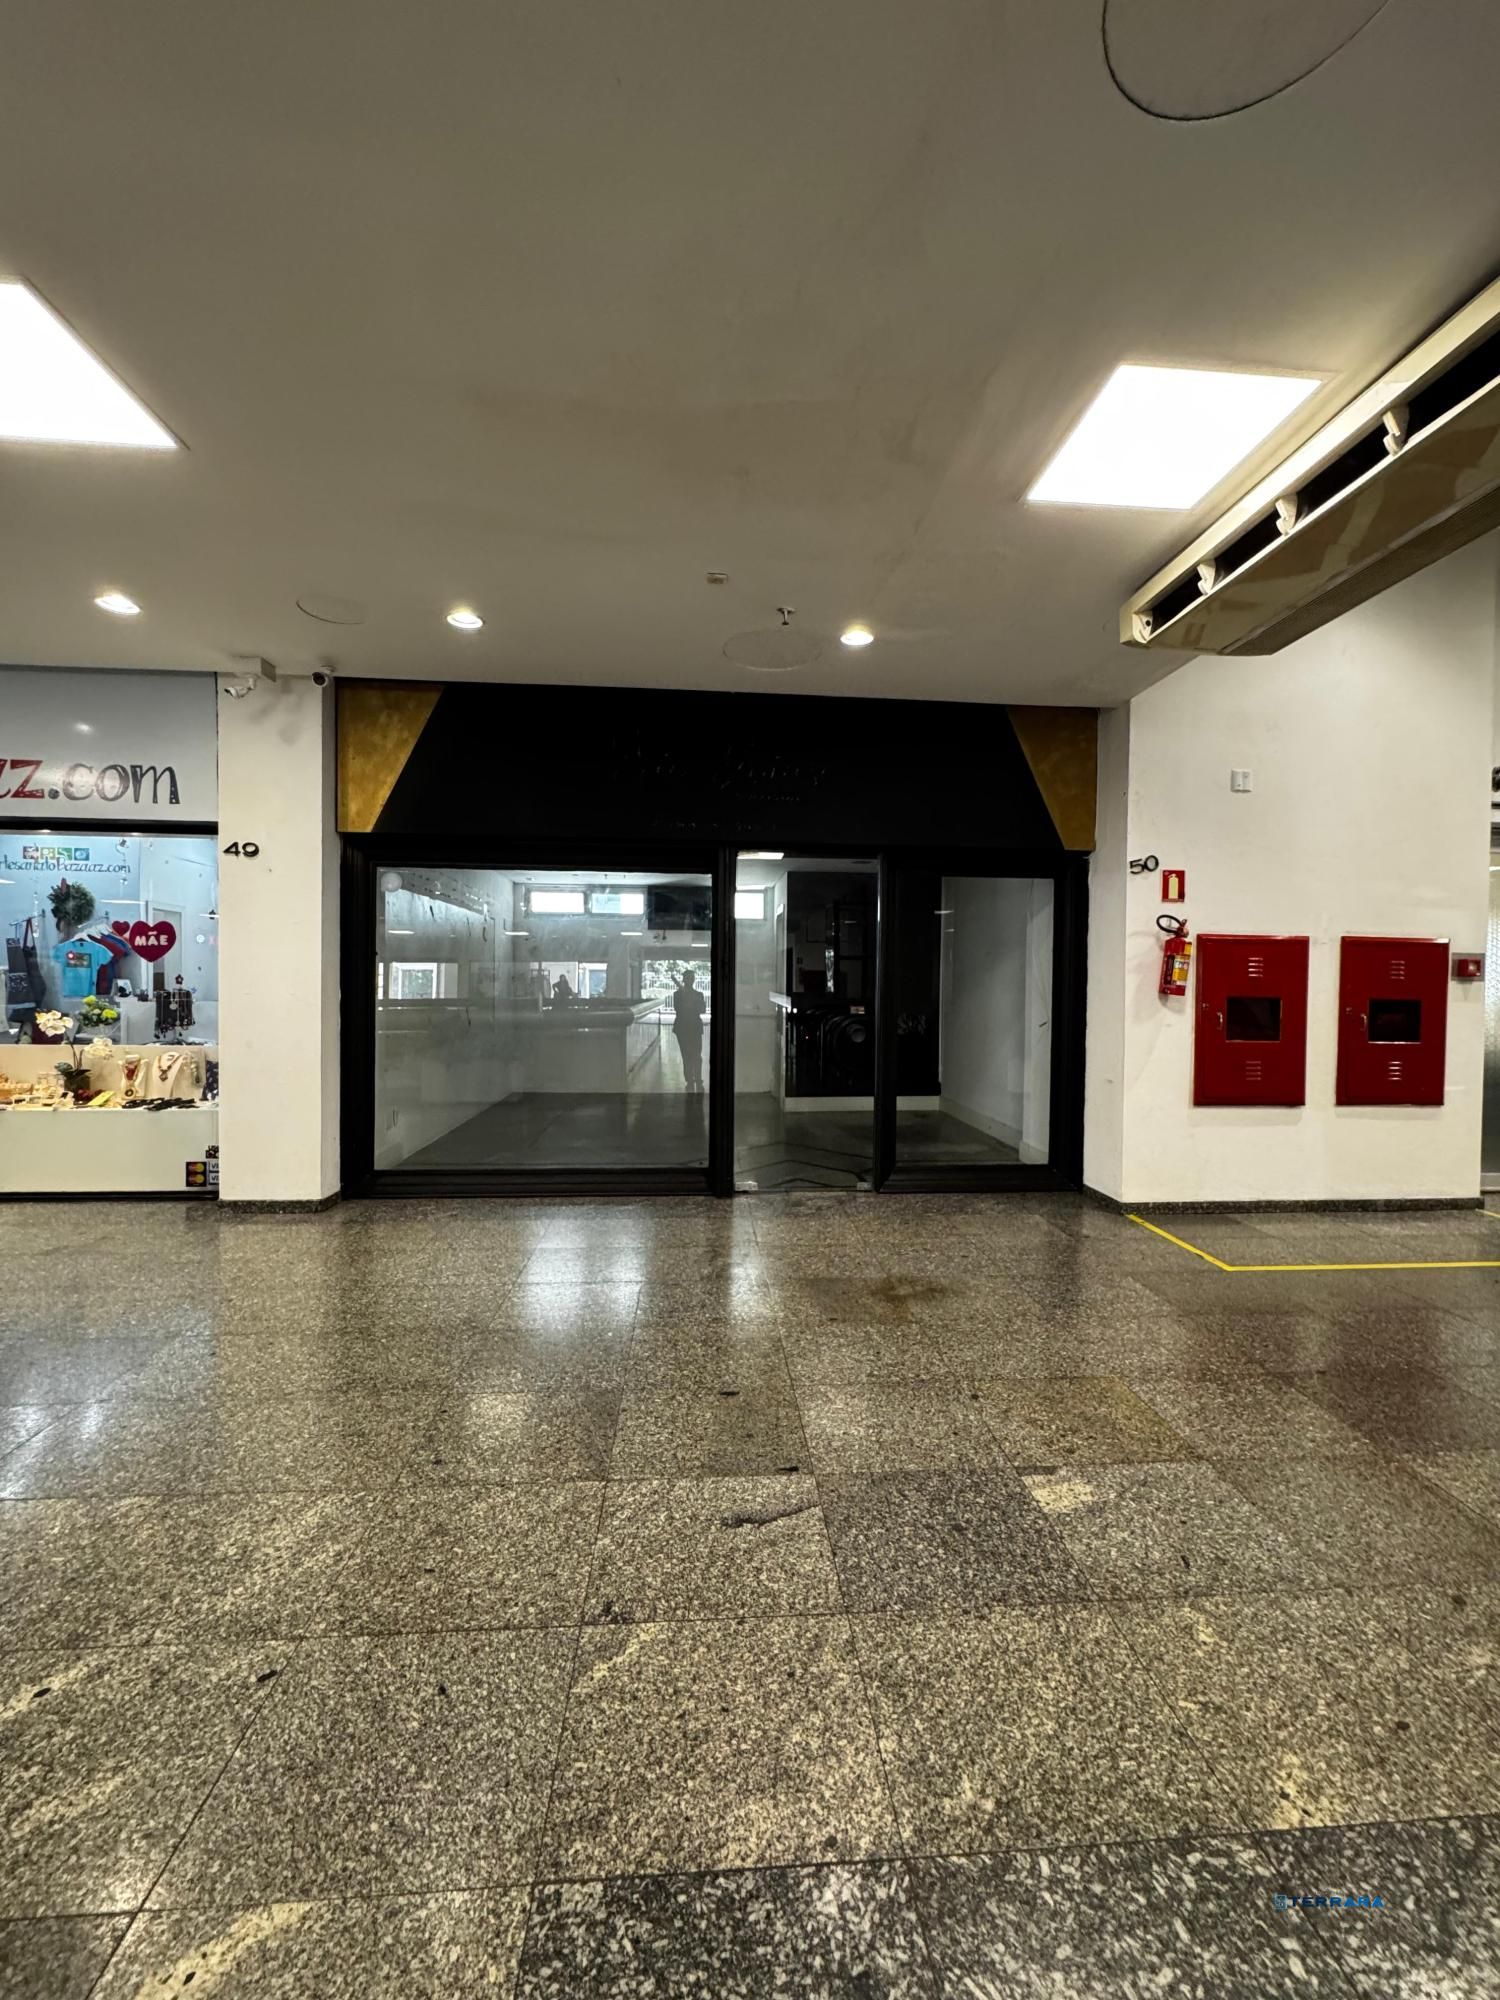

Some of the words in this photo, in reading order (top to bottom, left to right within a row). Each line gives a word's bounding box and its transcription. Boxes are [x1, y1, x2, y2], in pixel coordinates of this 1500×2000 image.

[223, 841, 260, 858] 49
[1129, 854, 1160, 874] 50
[134, 930, 169, 947] MÃE
